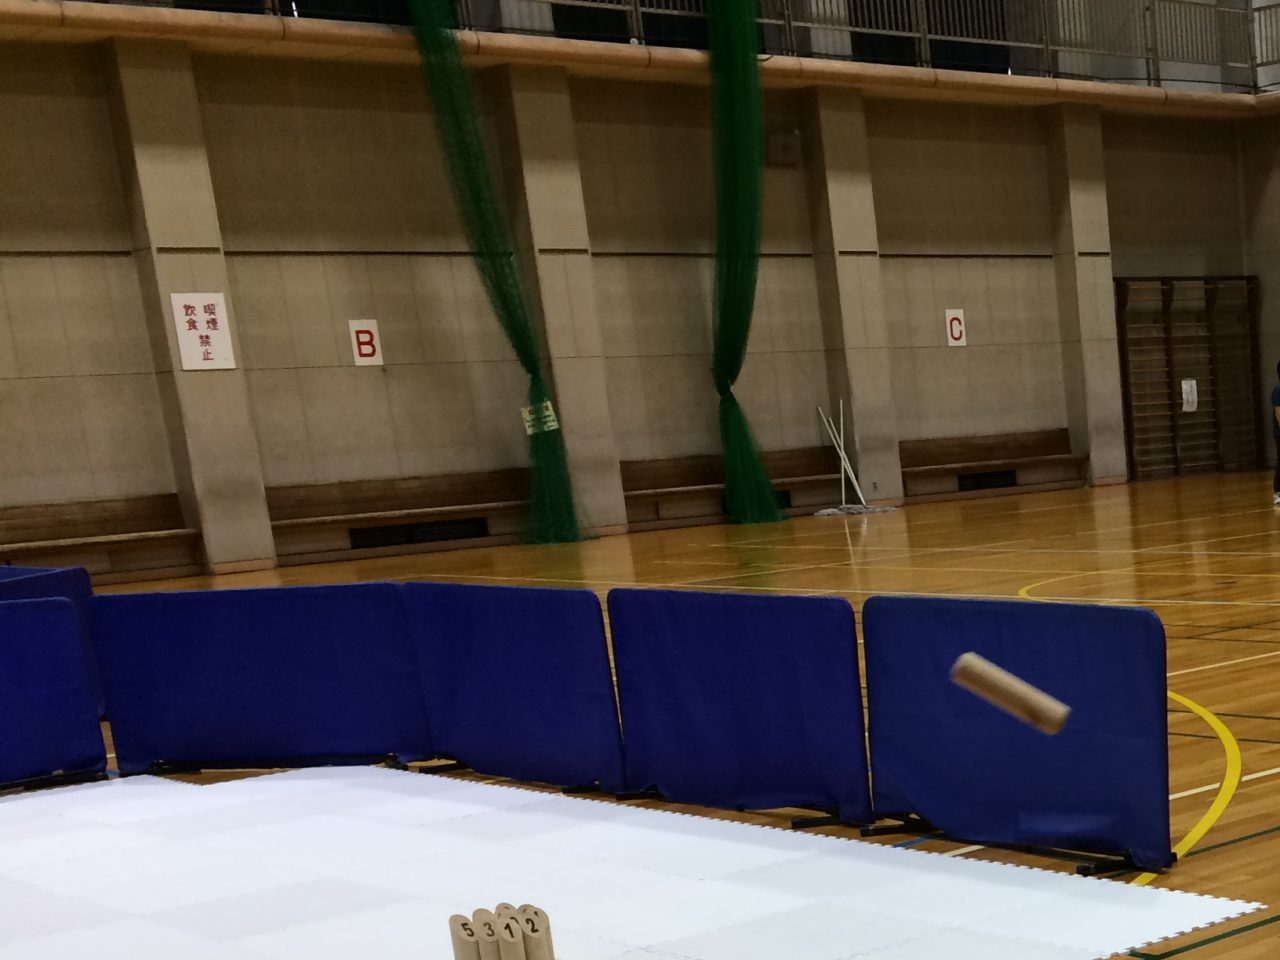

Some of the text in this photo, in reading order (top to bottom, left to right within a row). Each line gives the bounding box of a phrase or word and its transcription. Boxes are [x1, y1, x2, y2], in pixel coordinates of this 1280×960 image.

[183, 304, 199, 331] 飲食
[949, 317, 963, 341] C
[199, 334, 214, 361] 禁止
[355, 329, 377, 358] B
[460, 922, 476, 938] 5
[482, 921, 496, 938] 3
[503, 922, 516, 939] 1
[524, 917, 540, 934] 2
